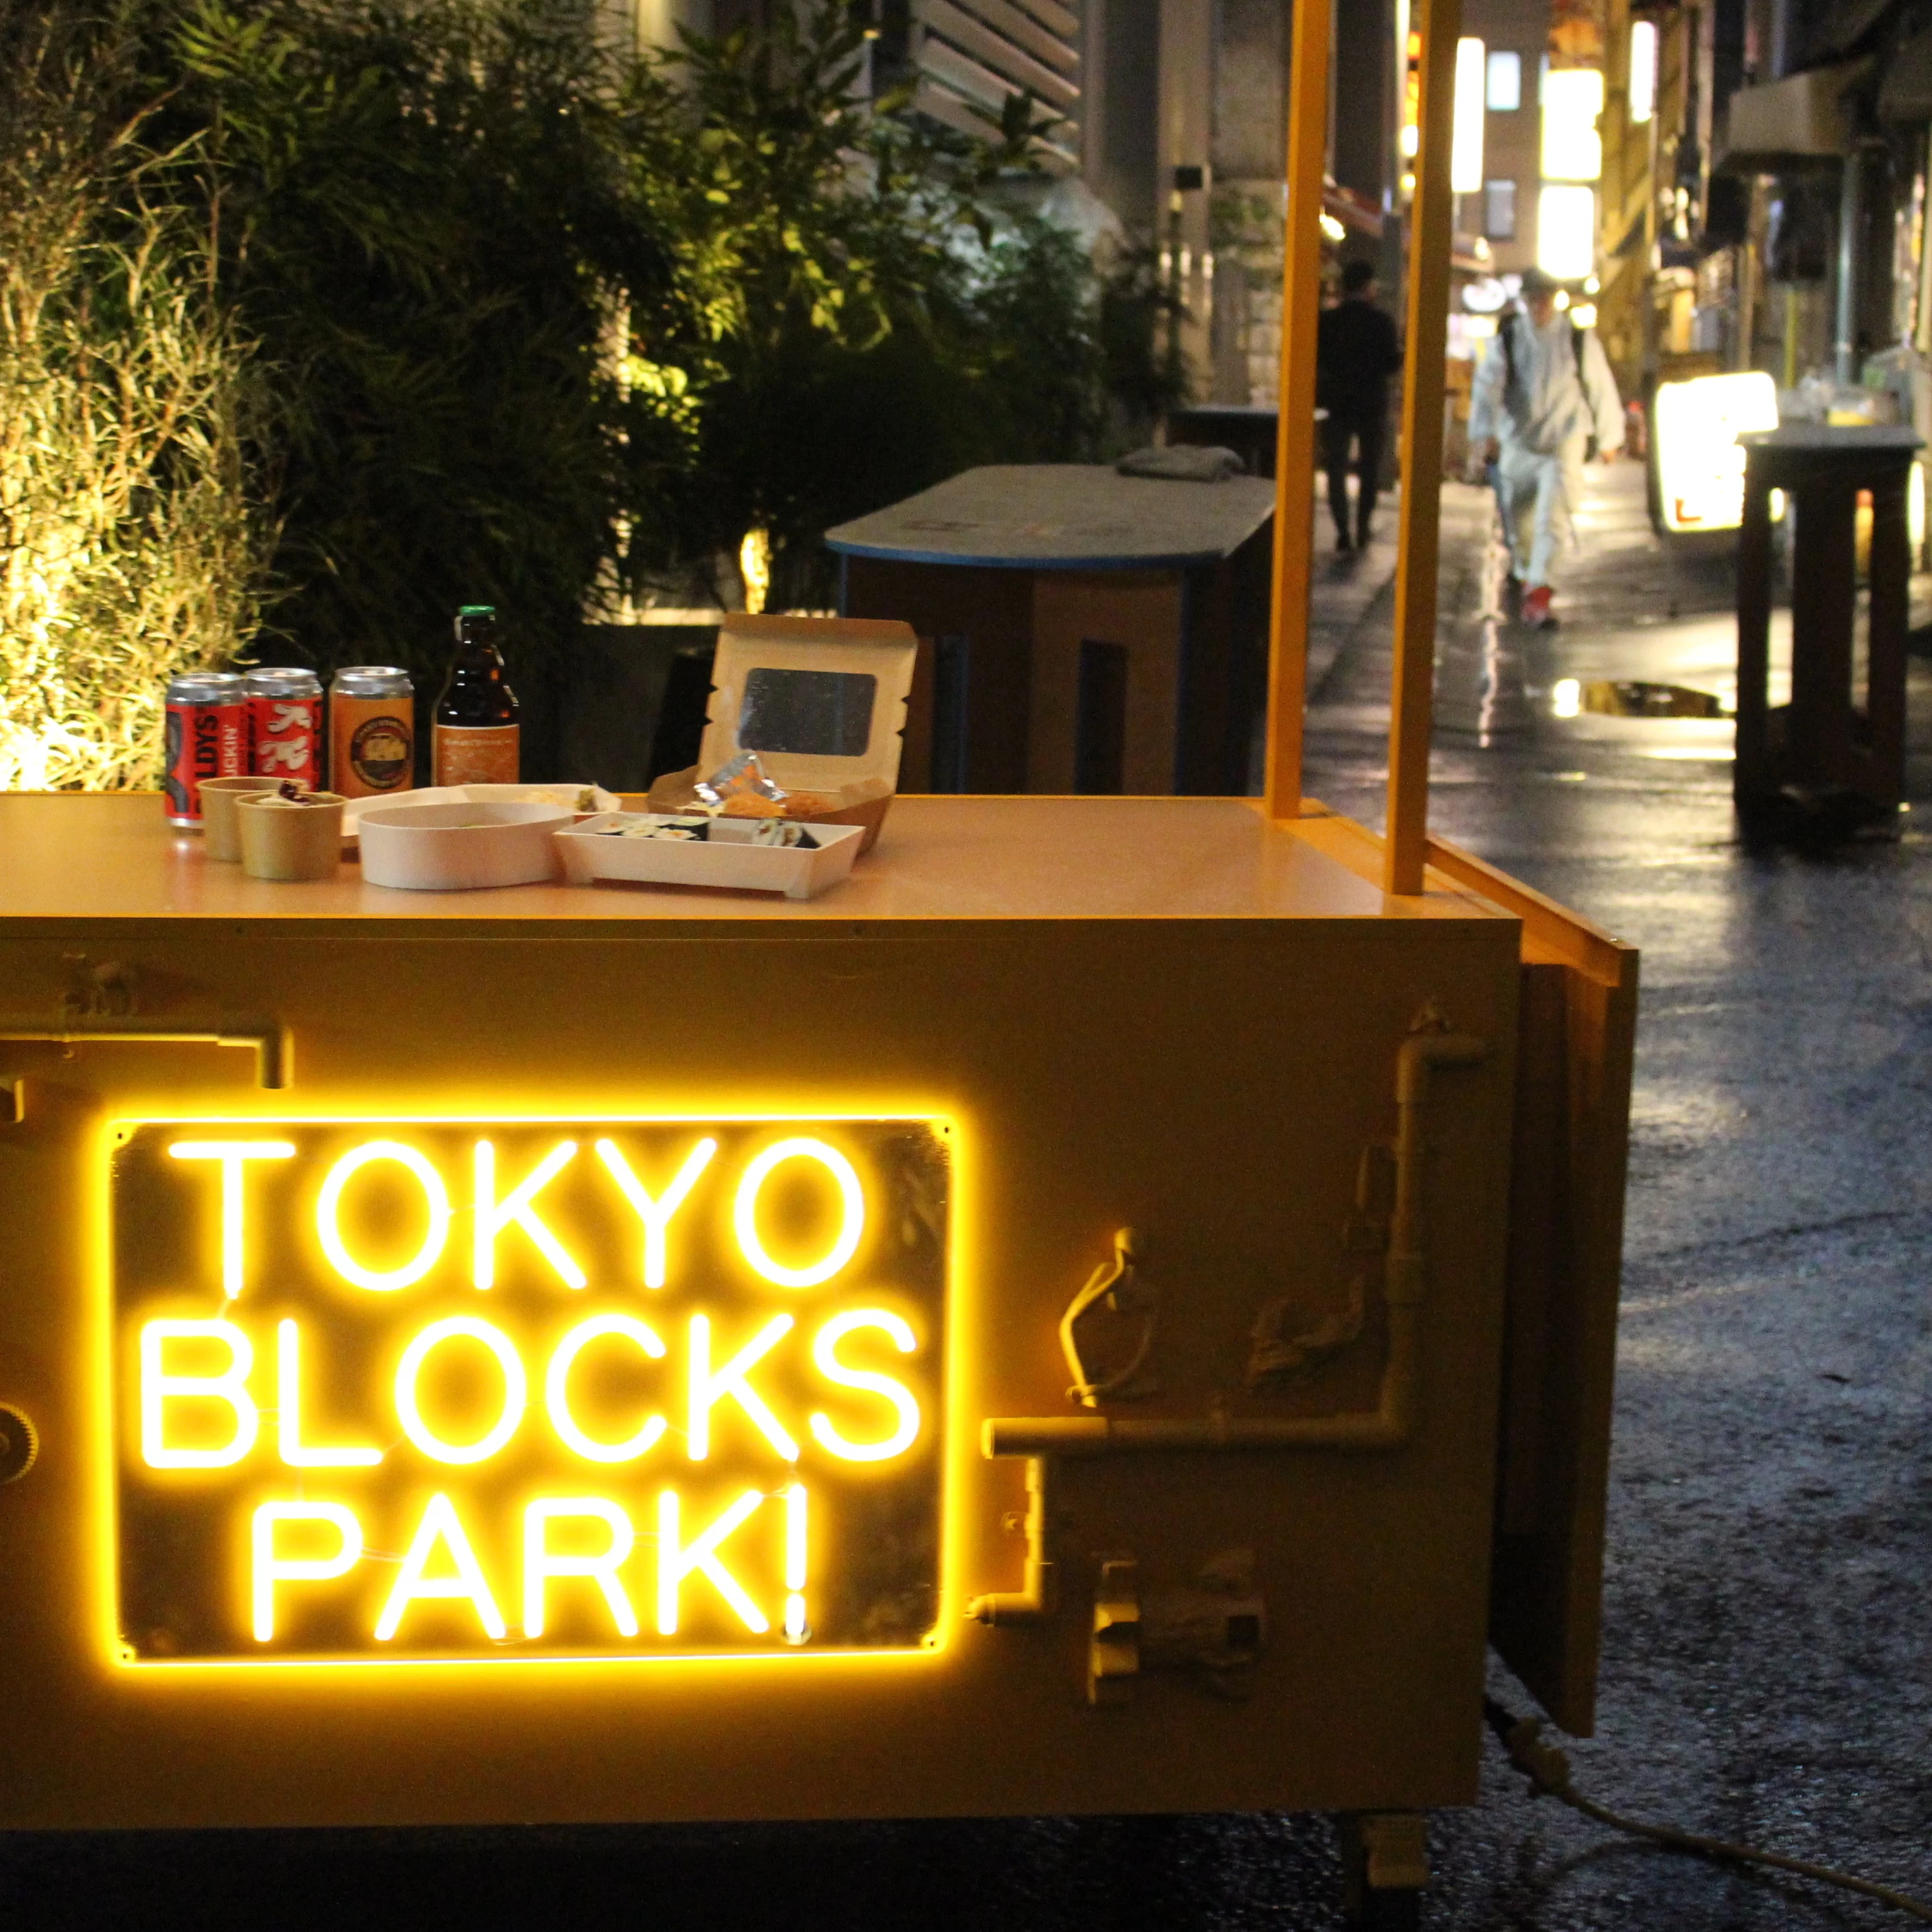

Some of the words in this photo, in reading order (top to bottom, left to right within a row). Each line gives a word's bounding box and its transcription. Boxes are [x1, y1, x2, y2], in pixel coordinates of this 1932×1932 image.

[167, 1137, 865, 1300] TOKYO
[140, 1308, 920, 1469] BLOCKS
[251, 1482, 808, 1644] PARK!
